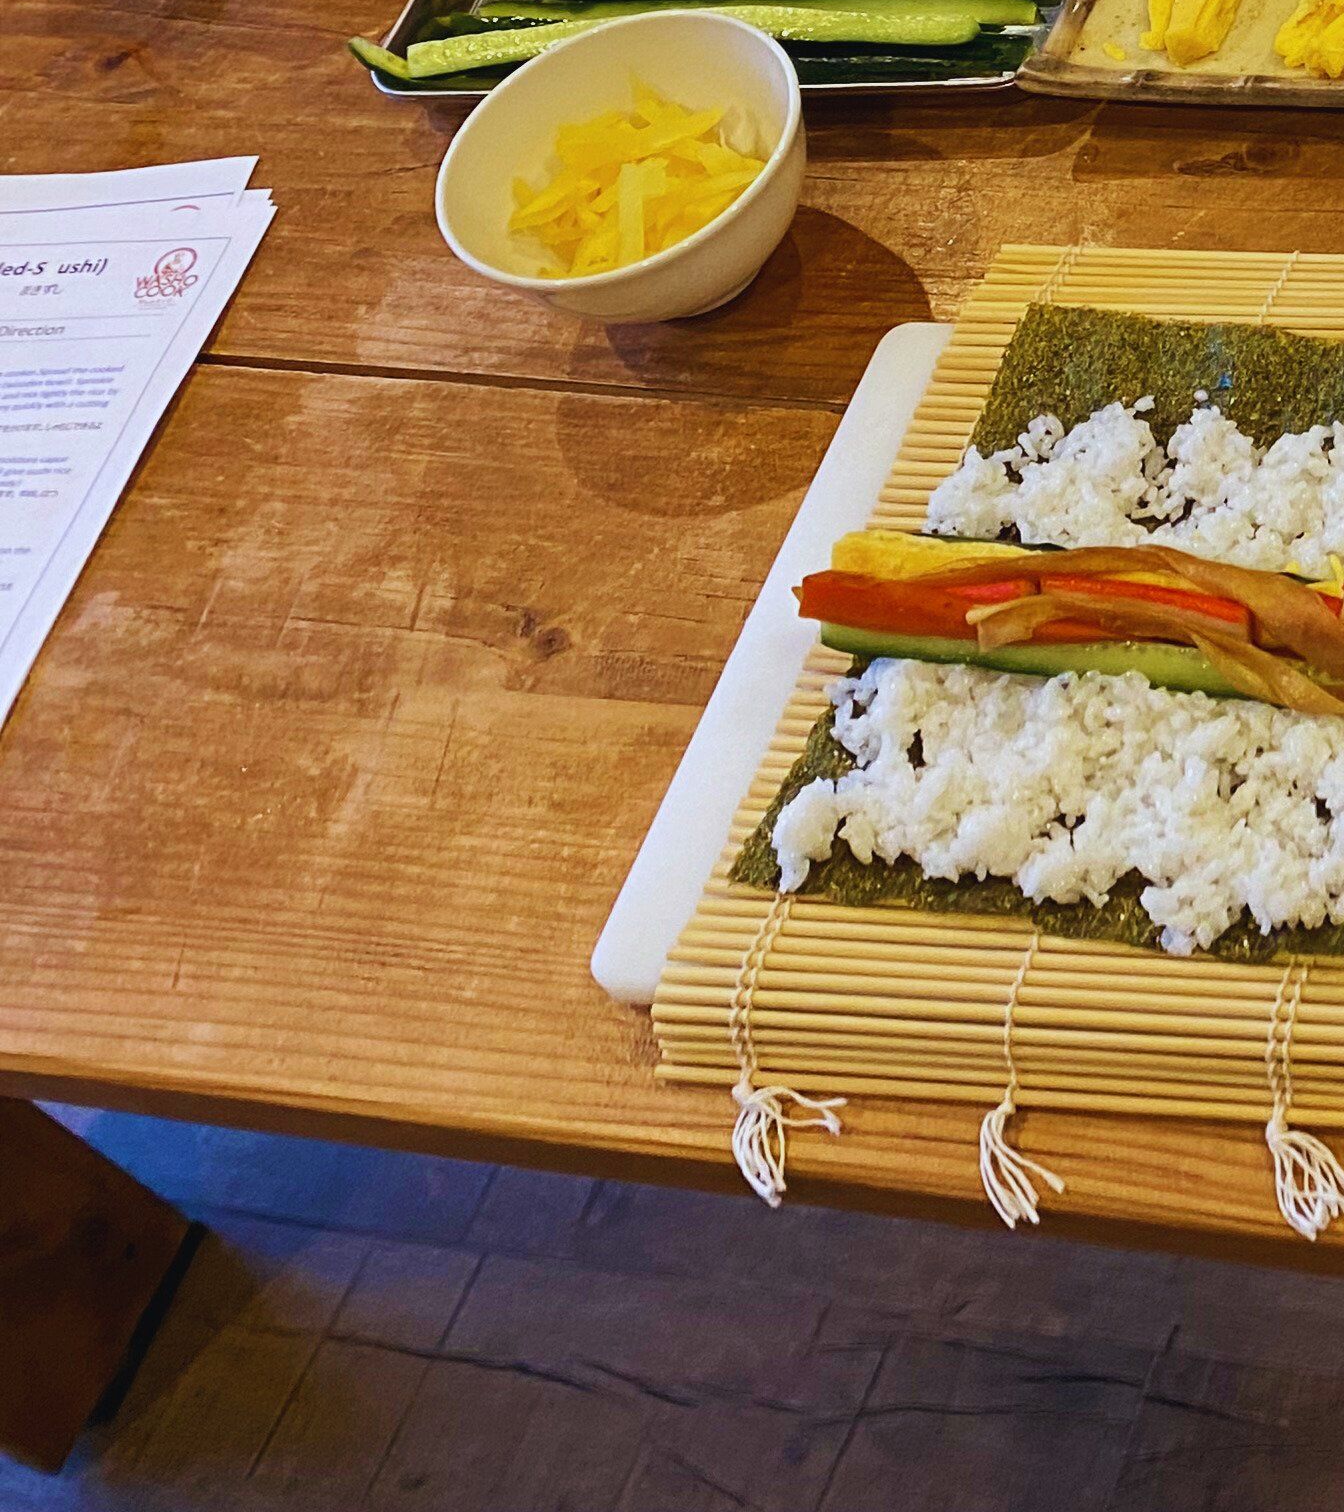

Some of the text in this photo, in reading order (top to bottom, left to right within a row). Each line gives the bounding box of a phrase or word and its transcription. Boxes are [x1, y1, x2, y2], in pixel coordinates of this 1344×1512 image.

[57, 257, 108, 276] ushi)
[136, 274, 199, 289] WASHO
[134, 285, 188, 299] COOK
[0, 324, 66, 337] Direction
